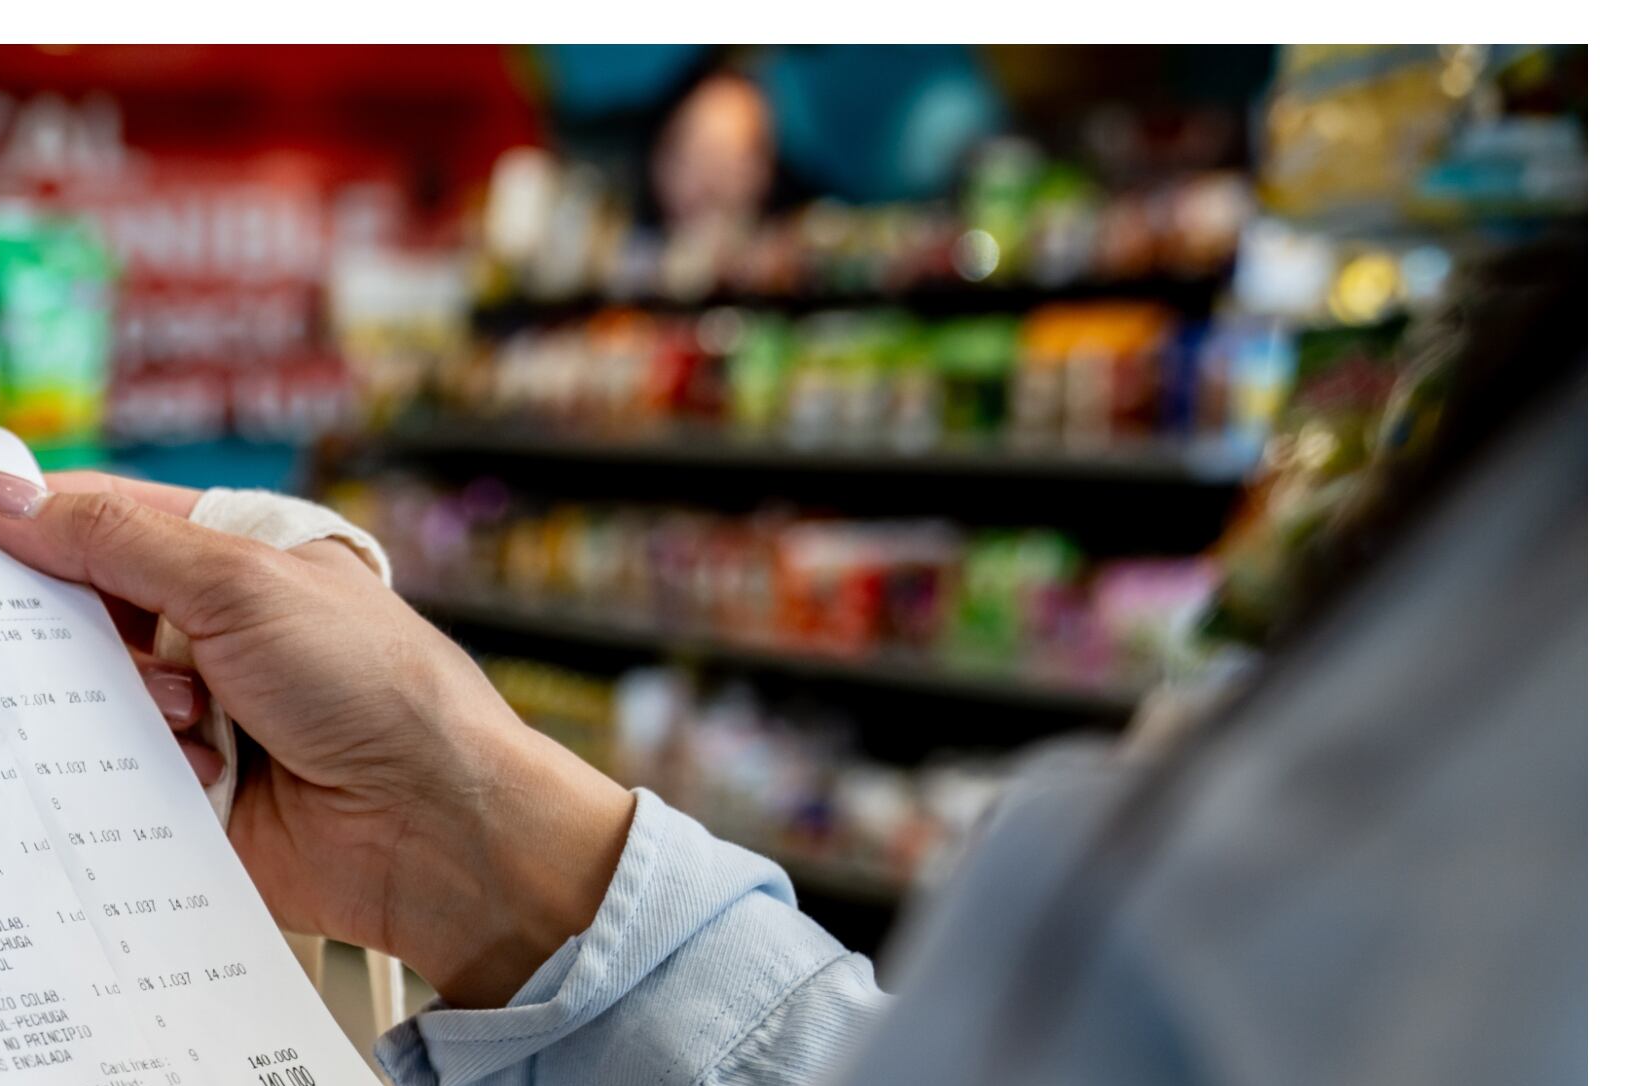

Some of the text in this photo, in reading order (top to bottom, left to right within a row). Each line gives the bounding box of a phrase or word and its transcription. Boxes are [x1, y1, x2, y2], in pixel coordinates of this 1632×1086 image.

[7, 597, 44, 611] VALOR
[99, 757, 141, 773] 14.000
[19, 840, 30, 854] 1
[88, 829, 123, 845] 1.037
[132, 825, 174, 842] 14.000
[55, 911, 65, 925] 1
[123, 899, 158, 915] 1.037
[168, 894, 210, 912] 14.000
[91, 984, 102, 998] 1
[158, 971, 193, 989] 1.037
[204, 962, 249, 983] 14.000
[20, 989, 68, 1009] COLAB.
[2, 1036, 21, 1052] NO
[23, 1025, 94, 1048] PRINCIPIO
[13, 1048, 75, 1071] ENSALADA
[188, 1048, 200, 1062] 9
[247, 1046, 300, 1070] 140.000
